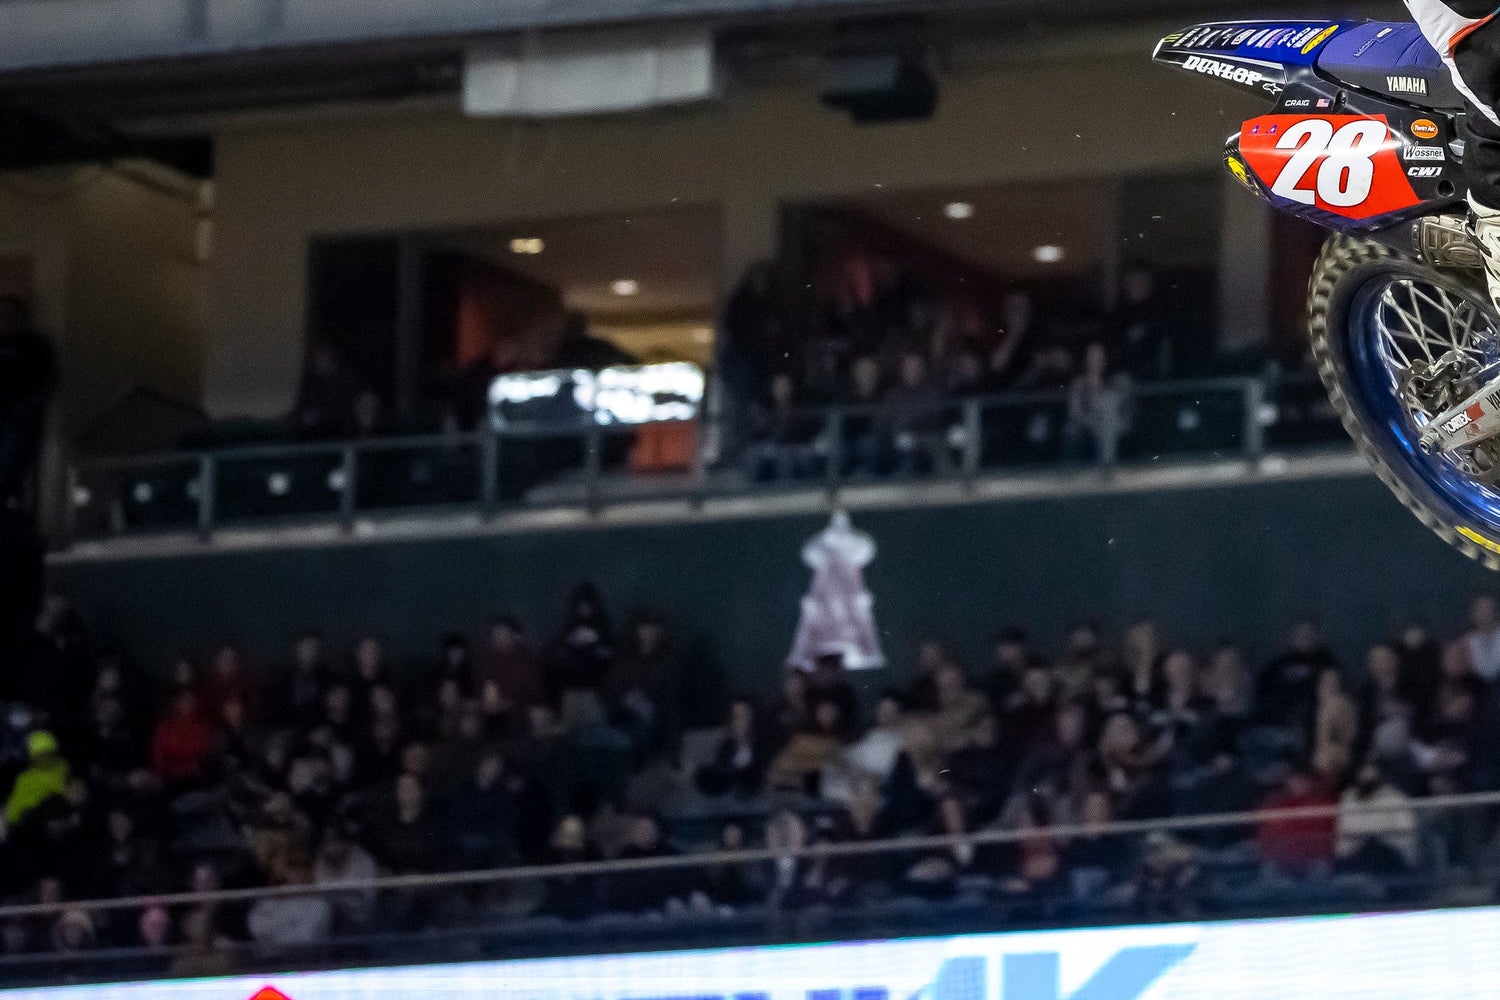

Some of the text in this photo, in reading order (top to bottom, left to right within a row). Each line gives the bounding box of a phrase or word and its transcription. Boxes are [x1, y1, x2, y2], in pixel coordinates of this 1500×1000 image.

[1182, 55, 1263, 87] DUNLOP
[1386, 76, 1427, 94] YAMAHA
[1284, 99, 1310, 107] CRAIG
[1271, 118, 1388, 207] 28
[1440, 409, 1473, 435] VORTEX
